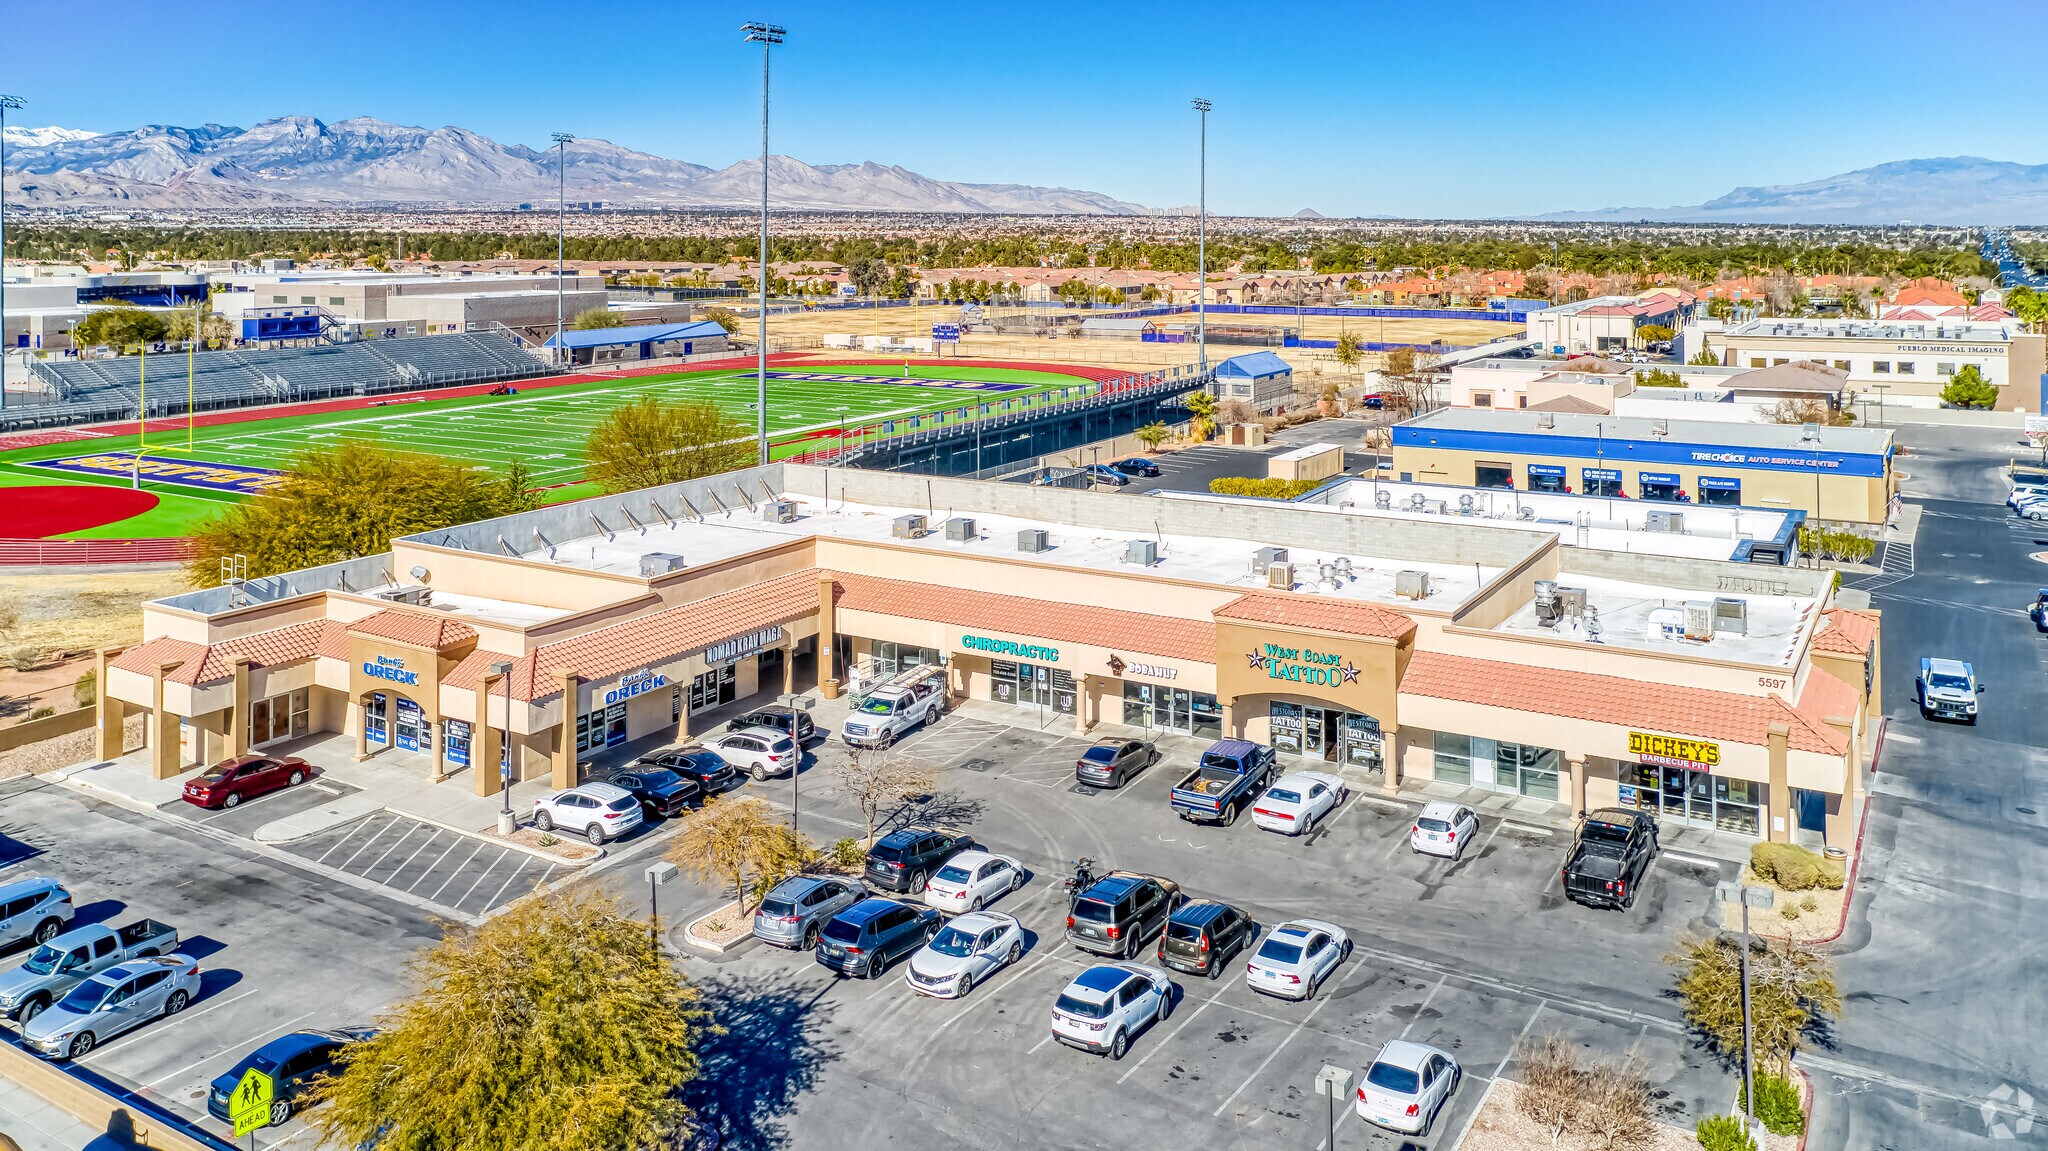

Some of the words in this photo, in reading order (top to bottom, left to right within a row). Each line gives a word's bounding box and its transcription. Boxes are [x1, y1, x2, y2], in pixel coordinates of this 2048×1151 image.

[1748, 456, 1768, 464] AUTO
[1771, 457, 1805, 467] SERVICE
[1806, 459, 1839, 468] CENTER
[706, 640, 737, 664] NOMAD
[737, 632, 758, 653] KRAV
[759, 625, 782, 645] MAGA
[961, 634, 1059, 662] CHIROPRACTIC
[1264, 643, 1299, 660] WEST
[1302, 649, 1342, 666] COAST
[363, 662, 419, 687] ORECK
[1264, 657, 1342, 688] TATTOO
[603, 673, 665, 705] ORECK
[1758, 677, 1787, 690] 5597
[1271, 716, 1302, 729] TATTOO
[1347, 728, 1380, 741] TATTOO
[1641, 754, 1689, 767] BARBECUE
[1691, 761, 1706, 770] PIT
[239, 1110, 266, 1130] AHEAD
